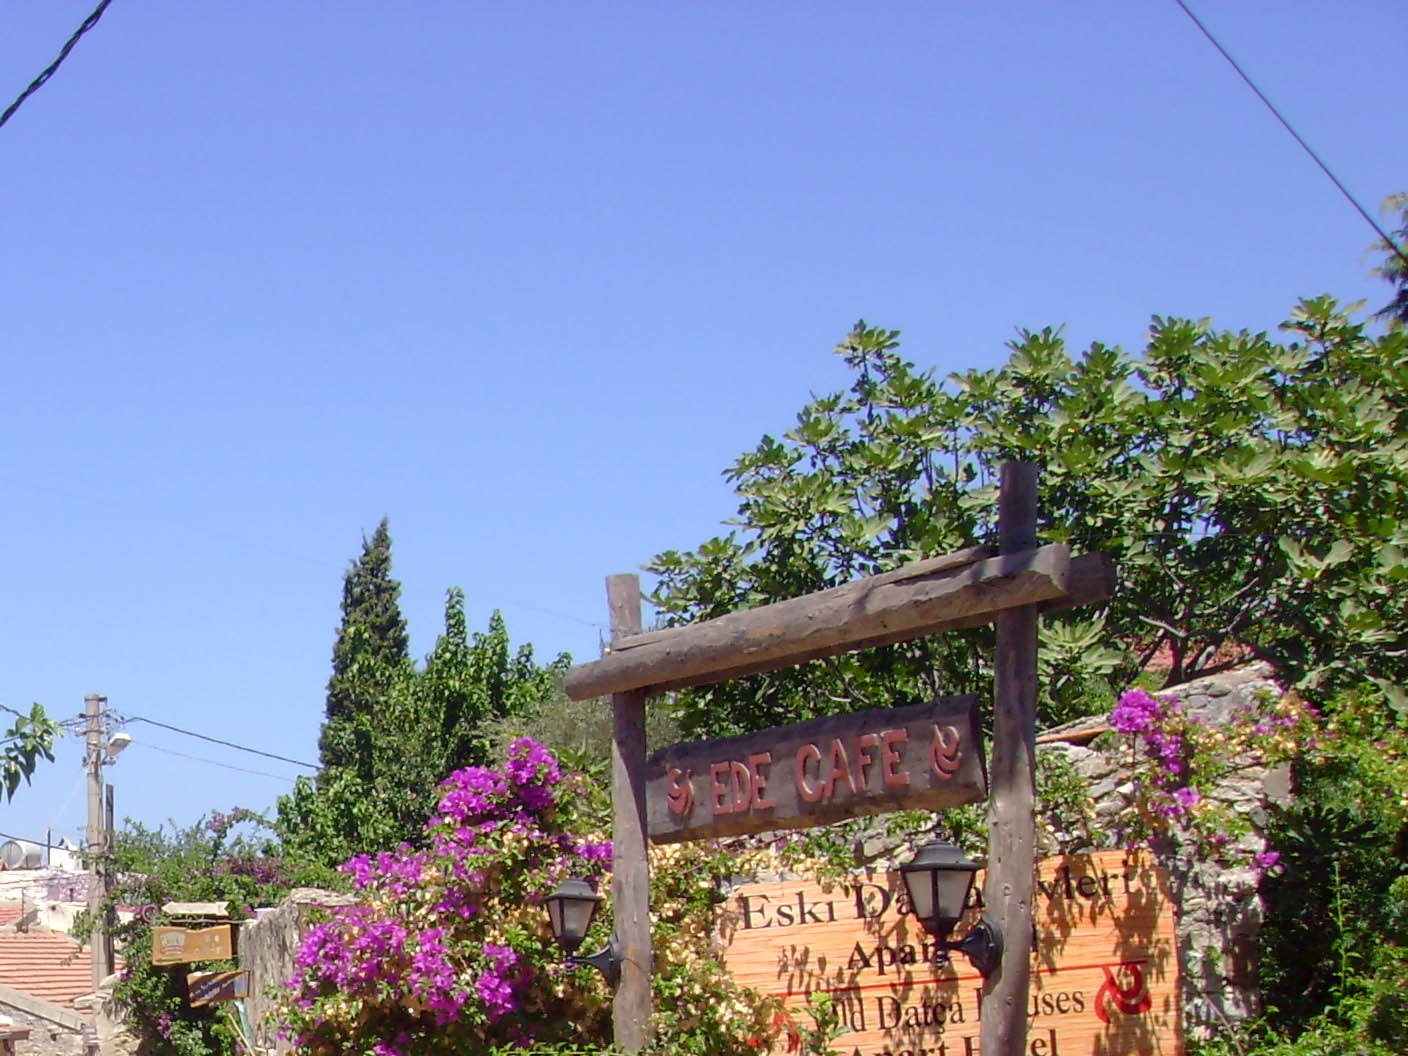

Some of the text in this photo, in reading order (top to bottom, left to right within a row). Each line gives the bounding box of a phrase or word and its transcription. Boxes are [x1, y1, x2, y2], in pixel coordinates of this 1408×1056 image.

[709, 728, 911, 816] EDE CAFE
[852, 884, 986, 919] Daa
[1028, 857, 1133, 902] vleri
[846, 940, 942, 976] Apar
[875, 995, 965, 1034] Datça
[974, 986, 1085, 1022] uses
